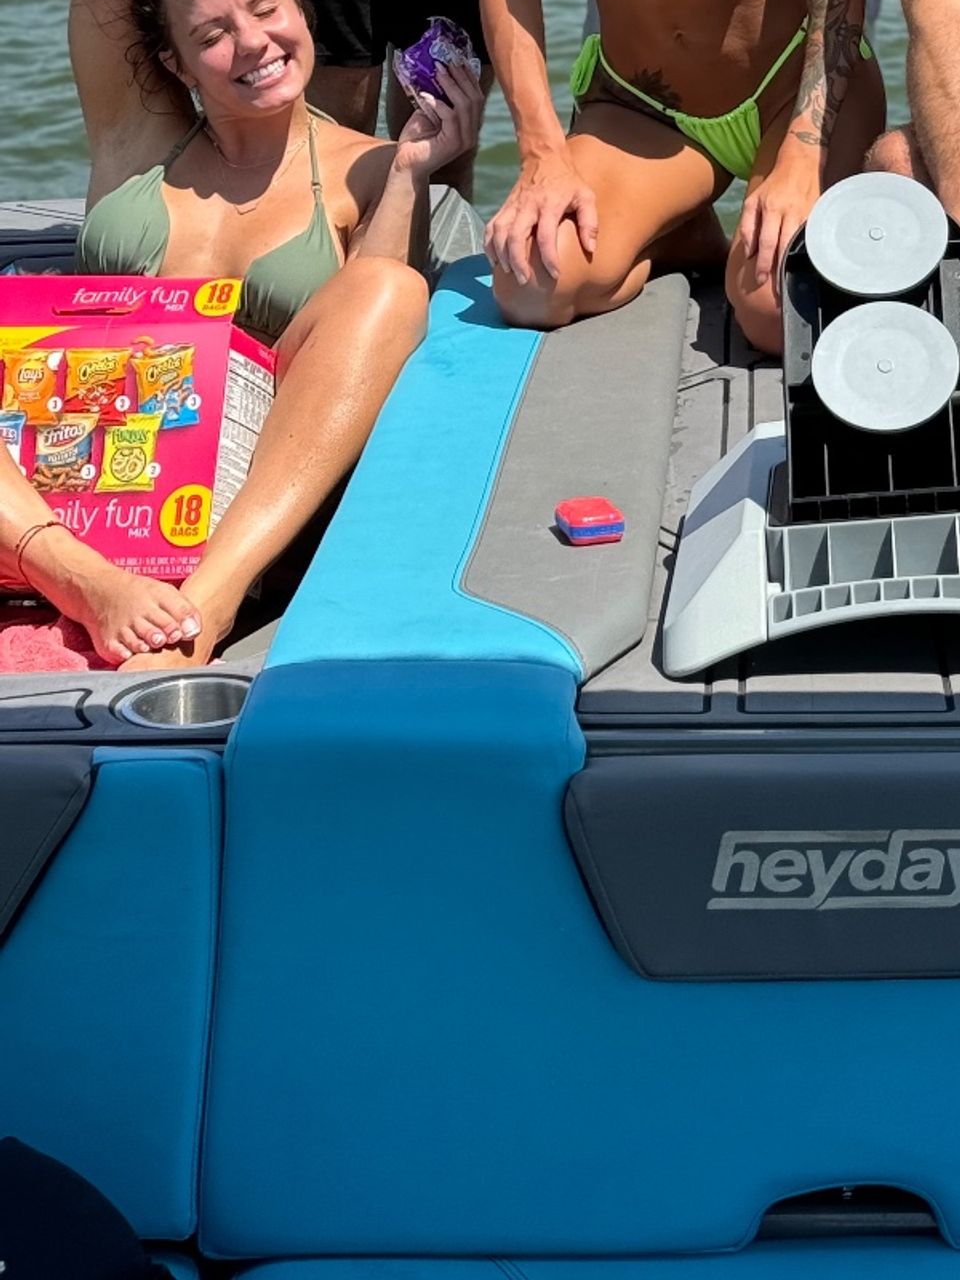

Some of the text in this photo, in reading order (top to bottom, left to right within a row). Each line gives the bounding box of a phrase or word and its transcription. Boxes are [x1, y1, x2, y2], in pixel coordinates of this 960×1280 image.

[71, 286, 189, 305] family fun
[207, 283, 234, 303] 18
[164, 304, 185, 312] MIX
[105, 498, 153, 528] fun
[174, 494, 204, 527] 18
[127, 527, 150, 538] MIX
[170, 526, 199, 538] BAGS
